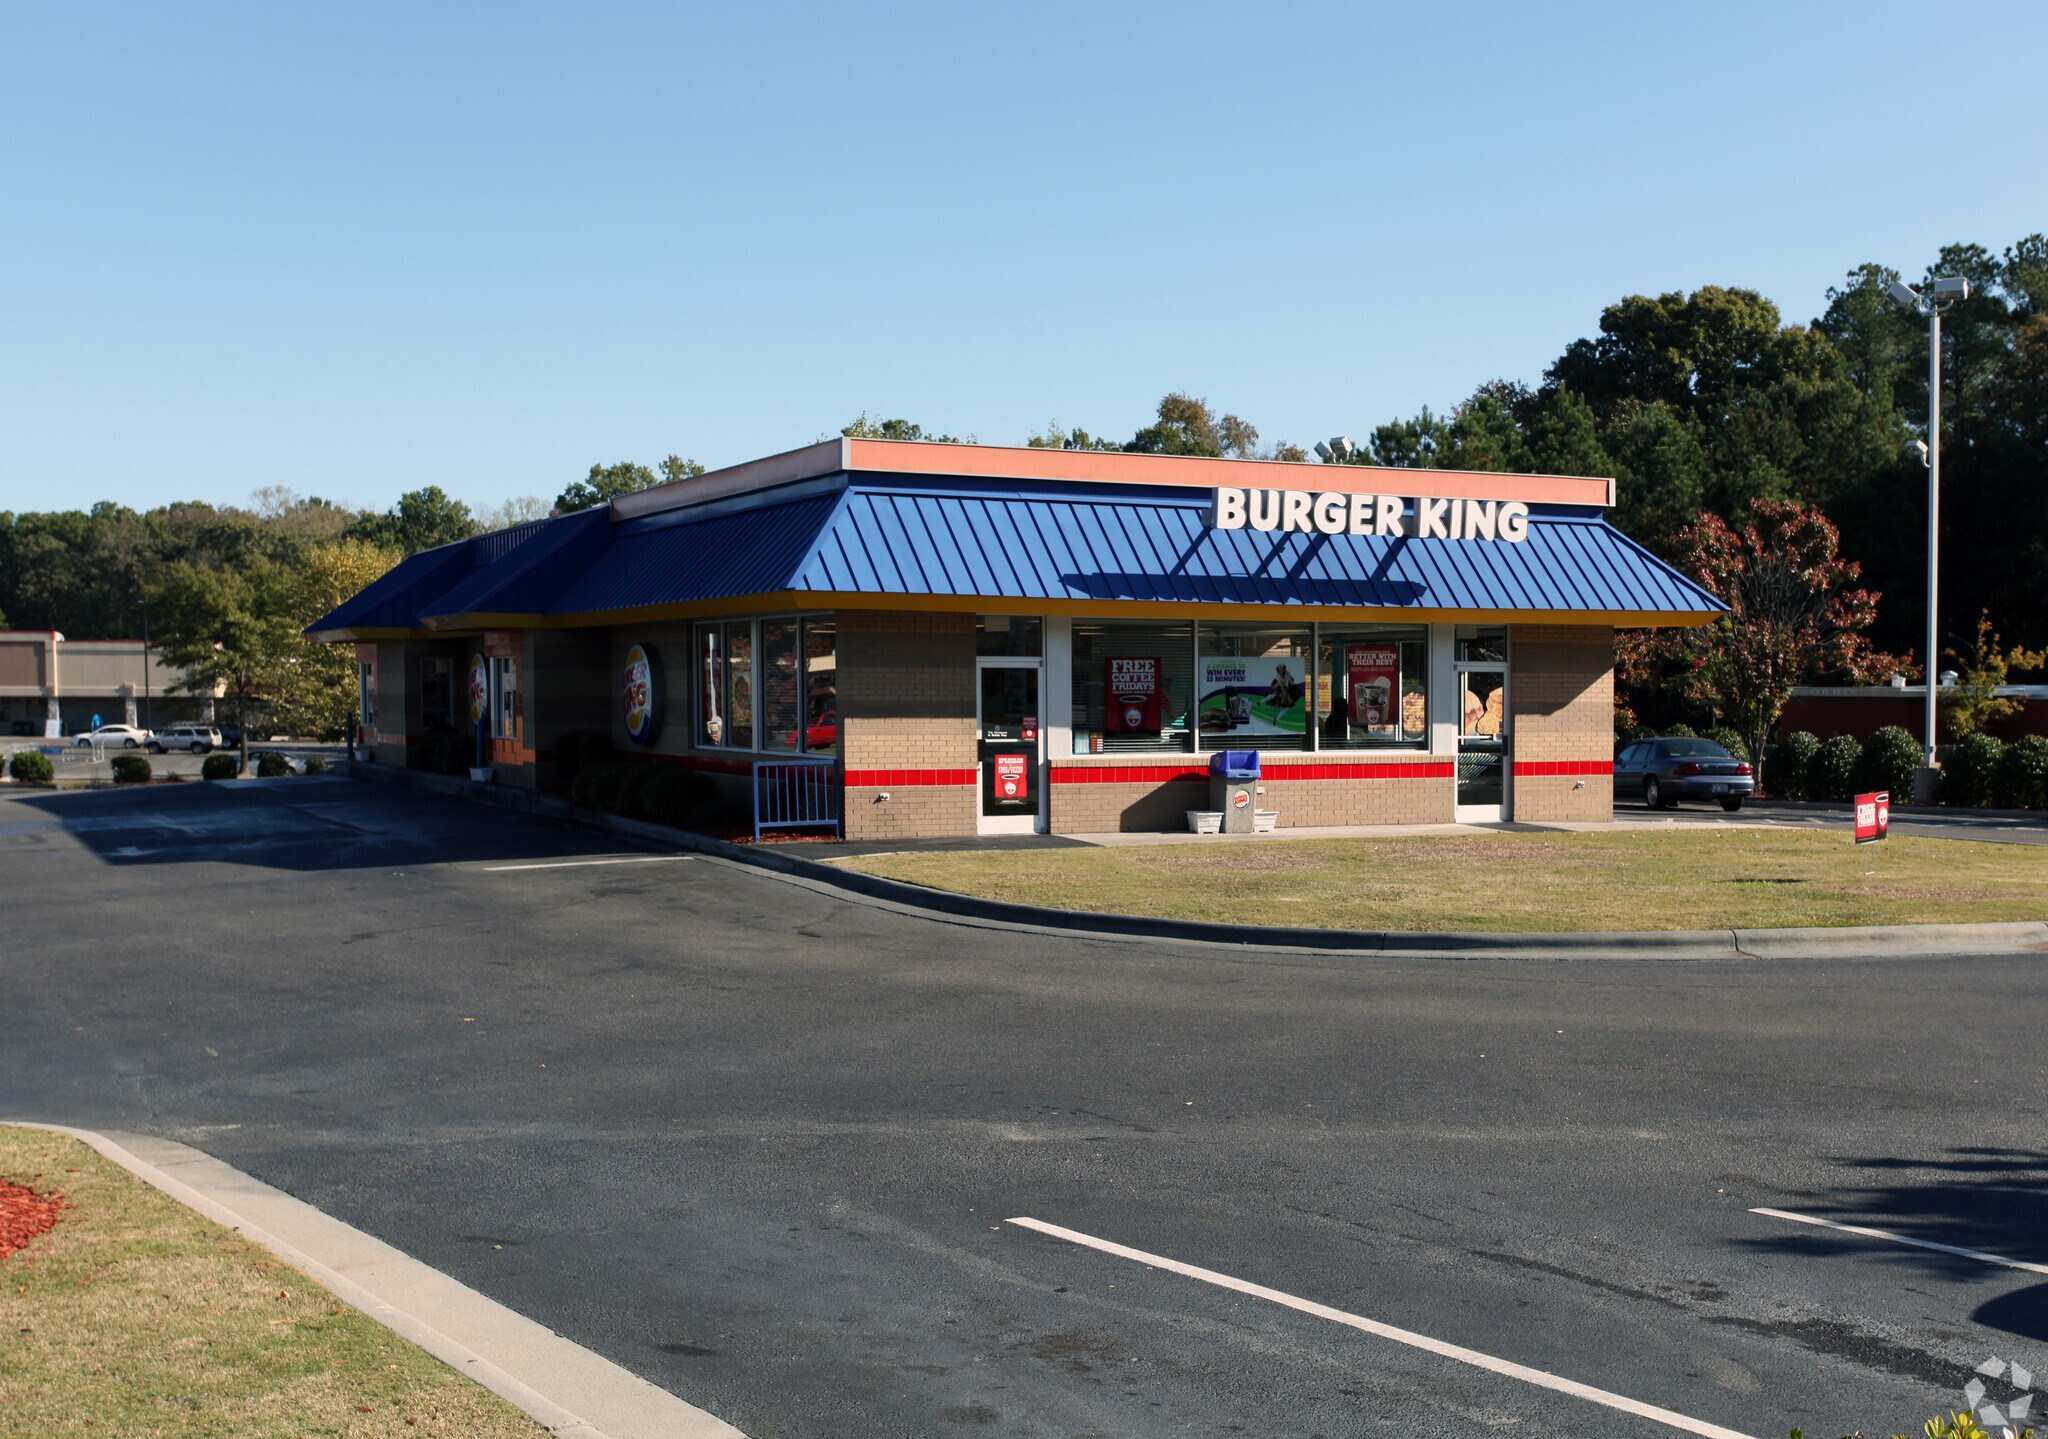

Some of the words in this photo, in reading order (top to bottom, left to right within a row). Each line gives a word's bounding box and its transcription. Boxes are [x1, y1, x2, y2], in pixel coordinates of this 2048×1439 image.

[1216, 487, 1404, 538] BURGER
[1419, 497, 1529, 543] KING
[1111, 659, 1155, 673] FREE
[1111, 672, 1155, 682] COFFEE
[1111, 682, 1155, 690] FRIDAYS
